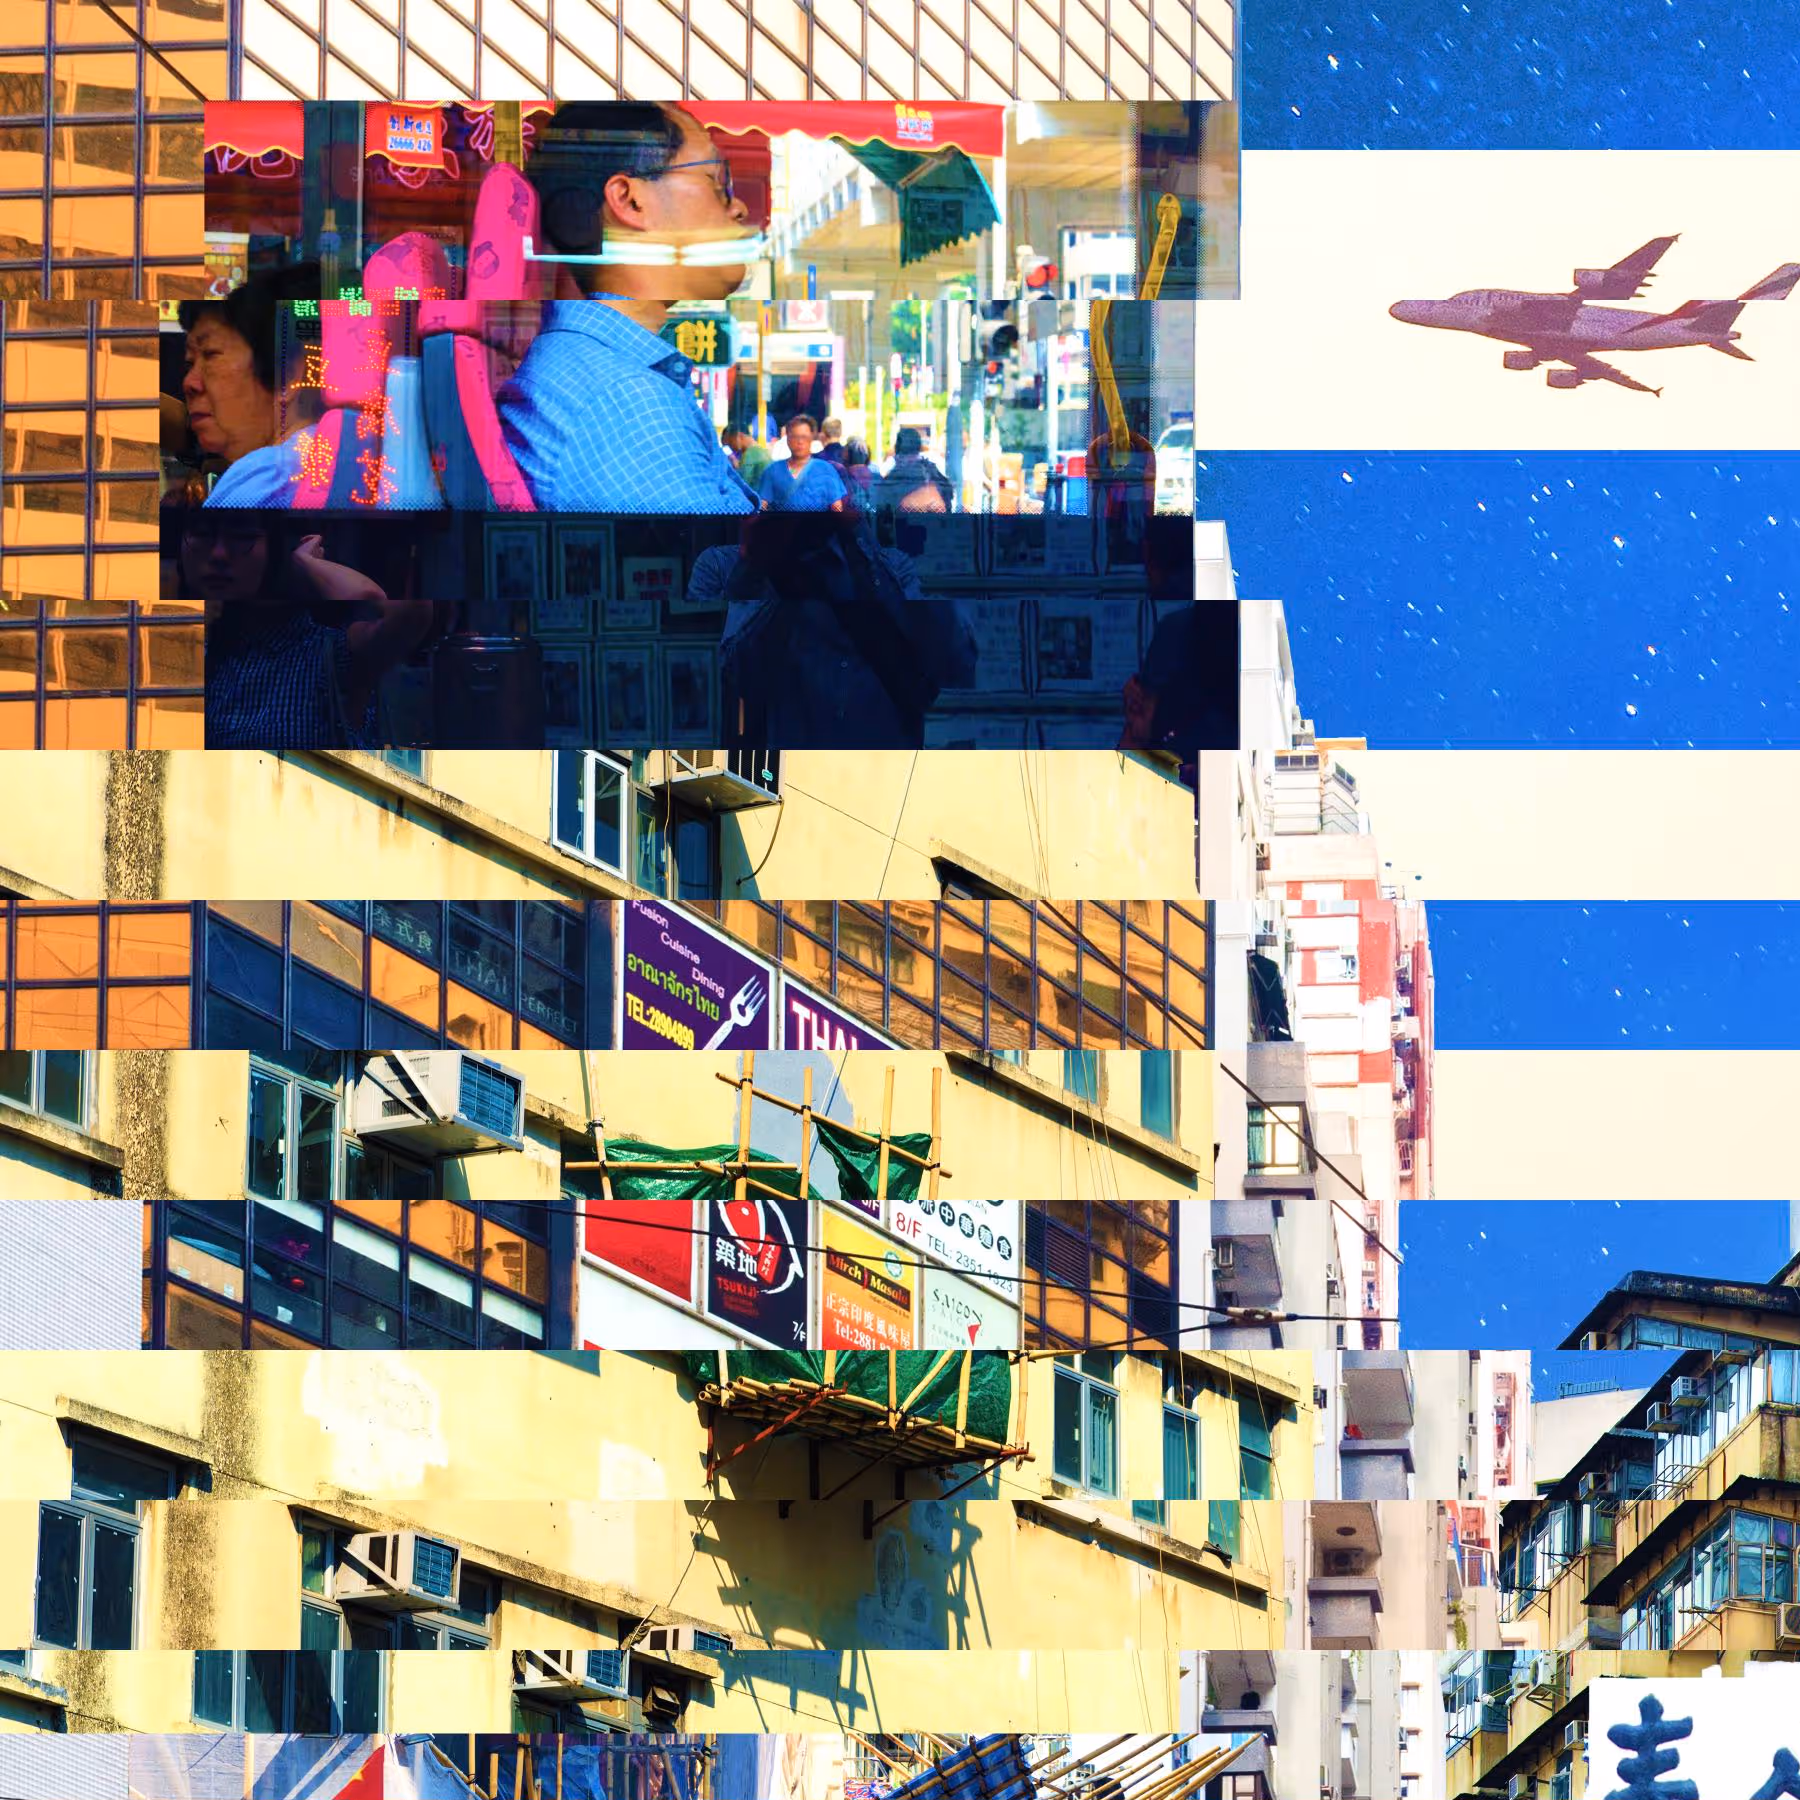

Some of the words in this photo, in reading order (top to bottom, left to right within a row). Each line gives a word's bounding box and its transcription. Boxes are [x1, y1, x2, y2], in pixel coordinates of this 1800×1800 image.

[660, 932, 700, 966] Cuisine
[691, 966, 726, 999] Dining
[895, 1212, 923, 1239] 8/F
